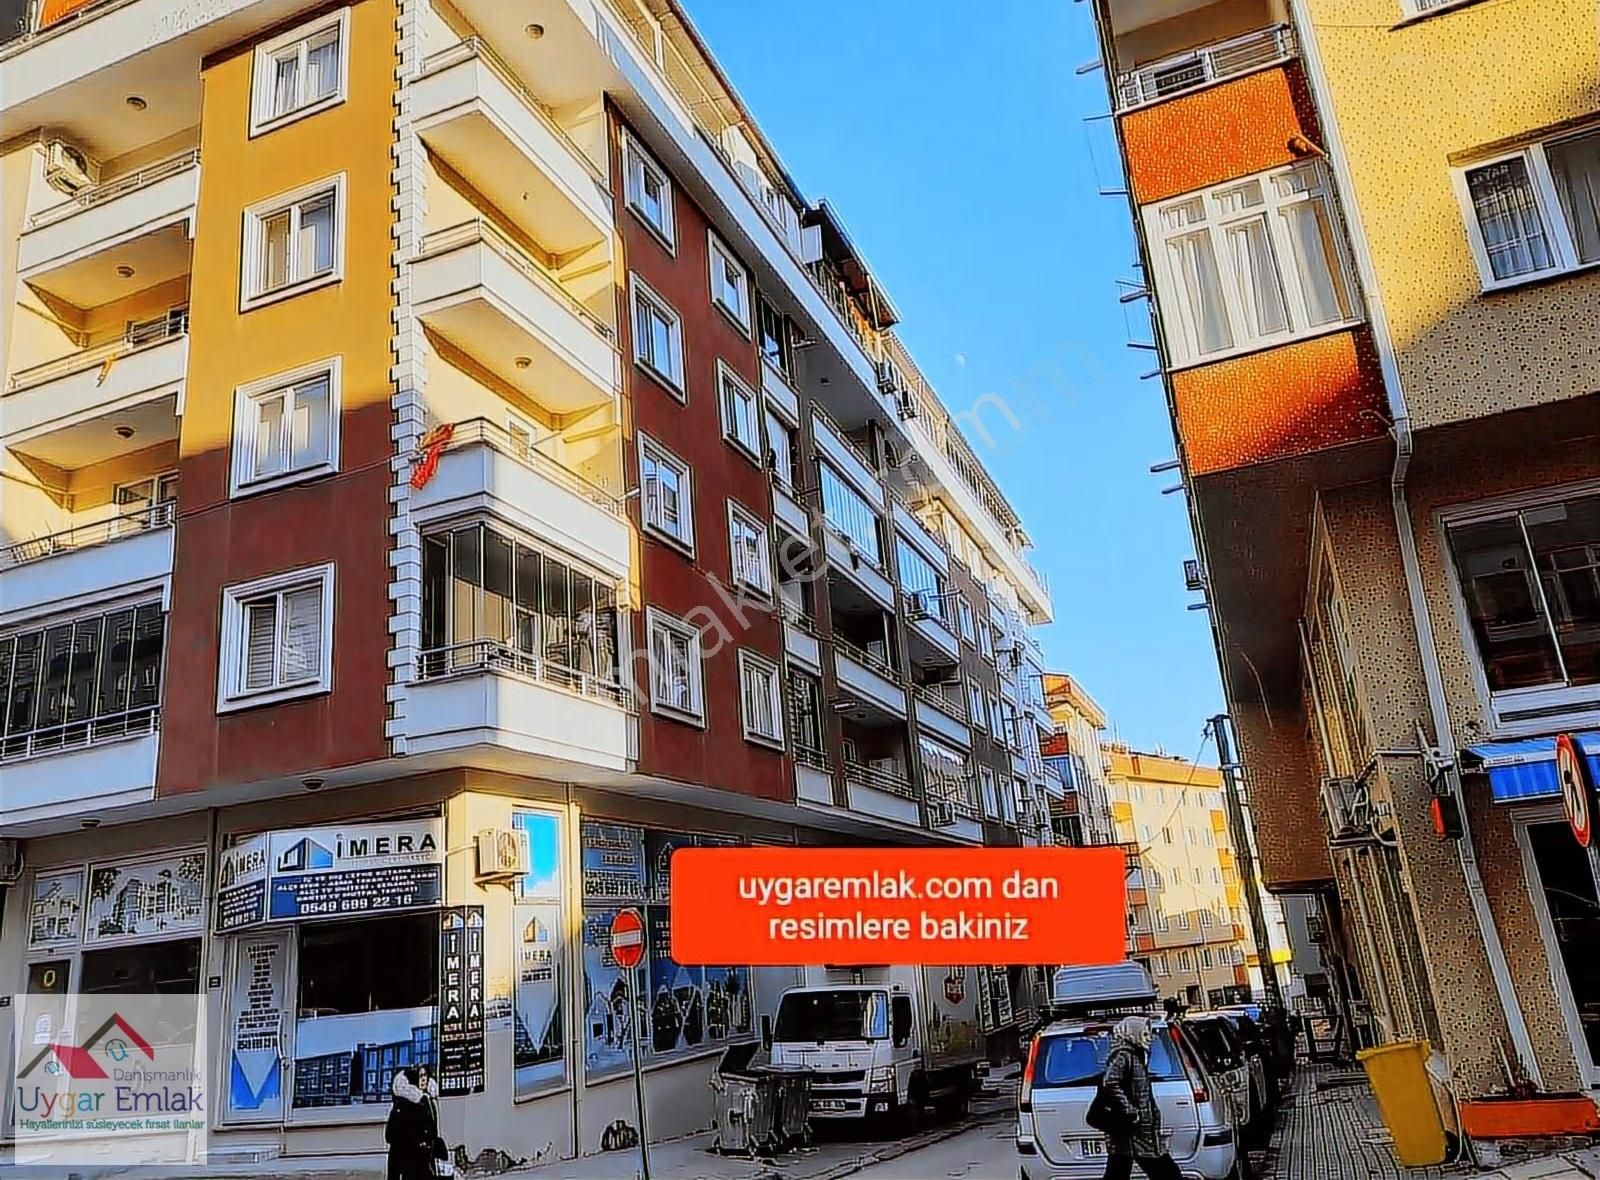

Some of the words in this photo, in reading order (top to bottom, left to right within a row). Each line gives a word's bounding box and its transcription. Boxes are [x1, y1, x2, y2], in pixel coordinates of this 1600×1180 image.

[336, 833, 436, 858] İMERA
[301, 901, 337, 915] 0549
[372, 897, 391, 908] 22
[394, 894, 412, 905] 16
[446, 933, 459, 1020] İMERA
[469, 932, 480, 1018] İMERA
